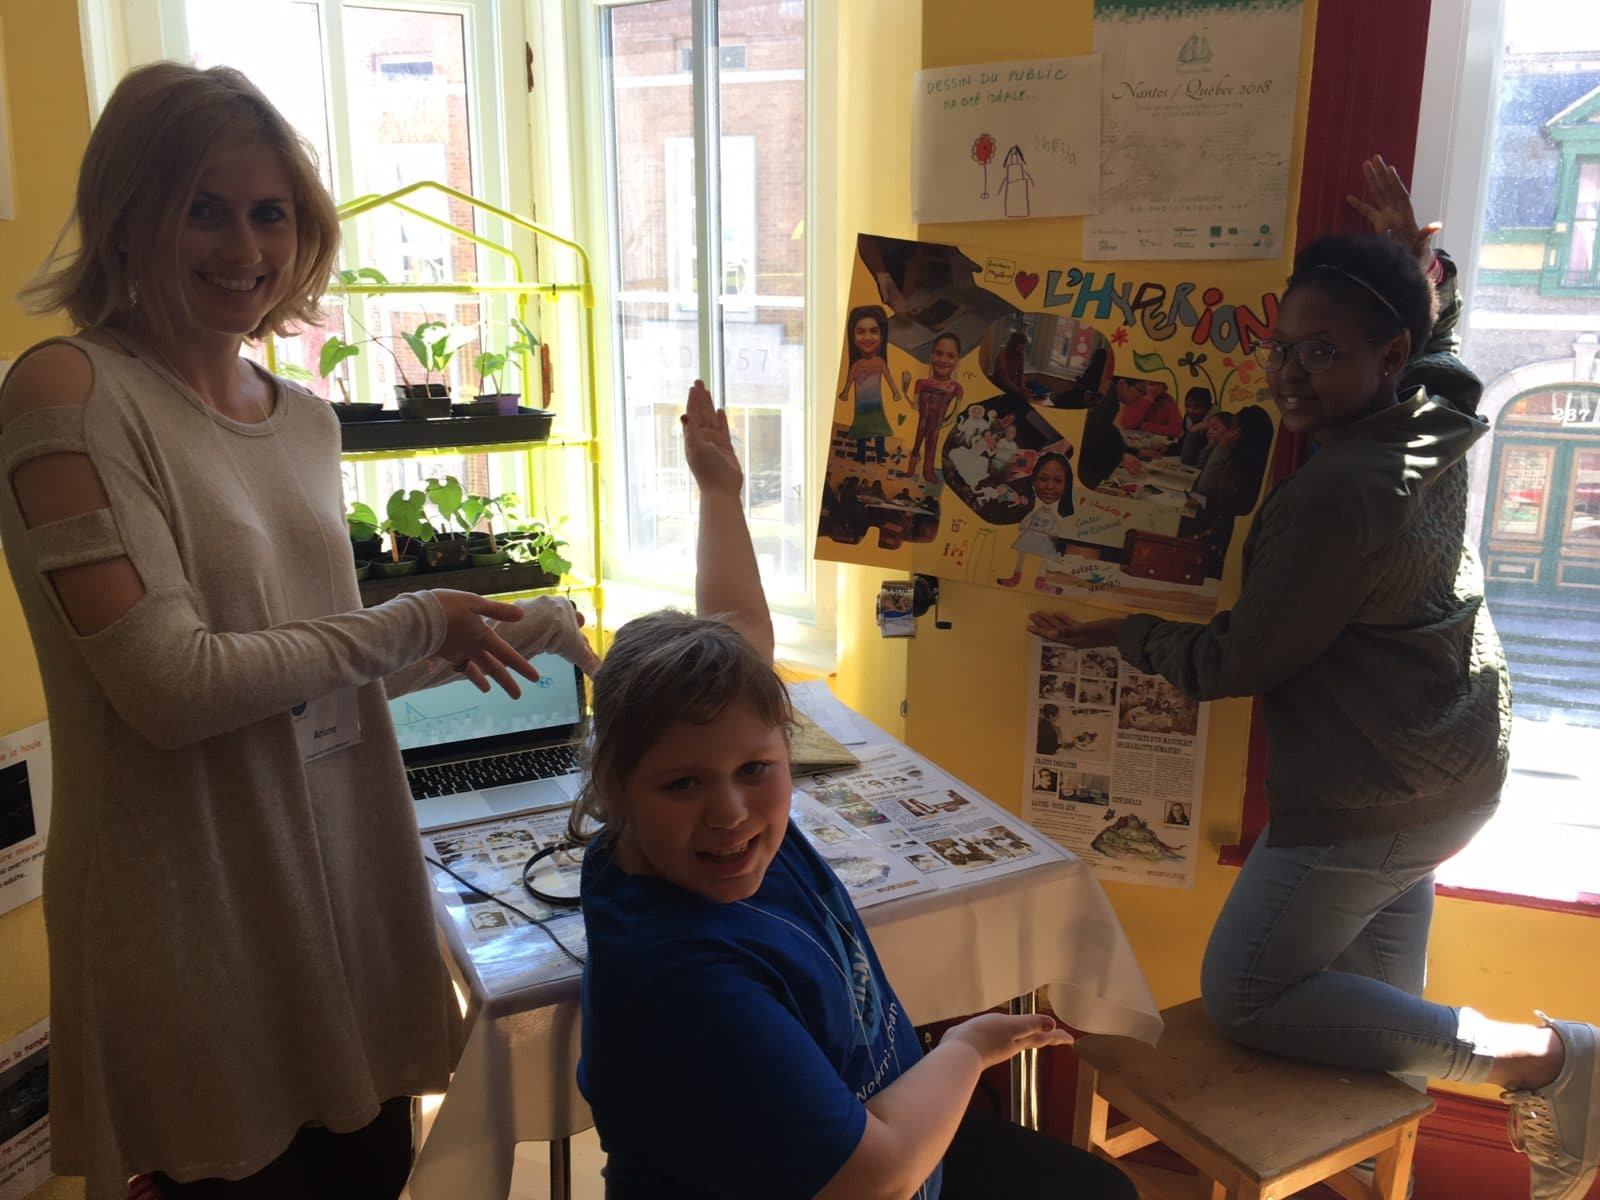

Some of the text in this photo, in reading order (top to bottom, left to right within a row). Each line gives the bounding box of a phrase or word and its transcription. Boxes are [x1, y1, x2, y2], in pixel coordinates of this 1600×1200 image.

[981, 72, 998, 85] DU
[1112, 80, 1168, 100] Nantes
[1185, 73, 1235, 101] Québec
[1237, 80, 1272, 96] 2018
